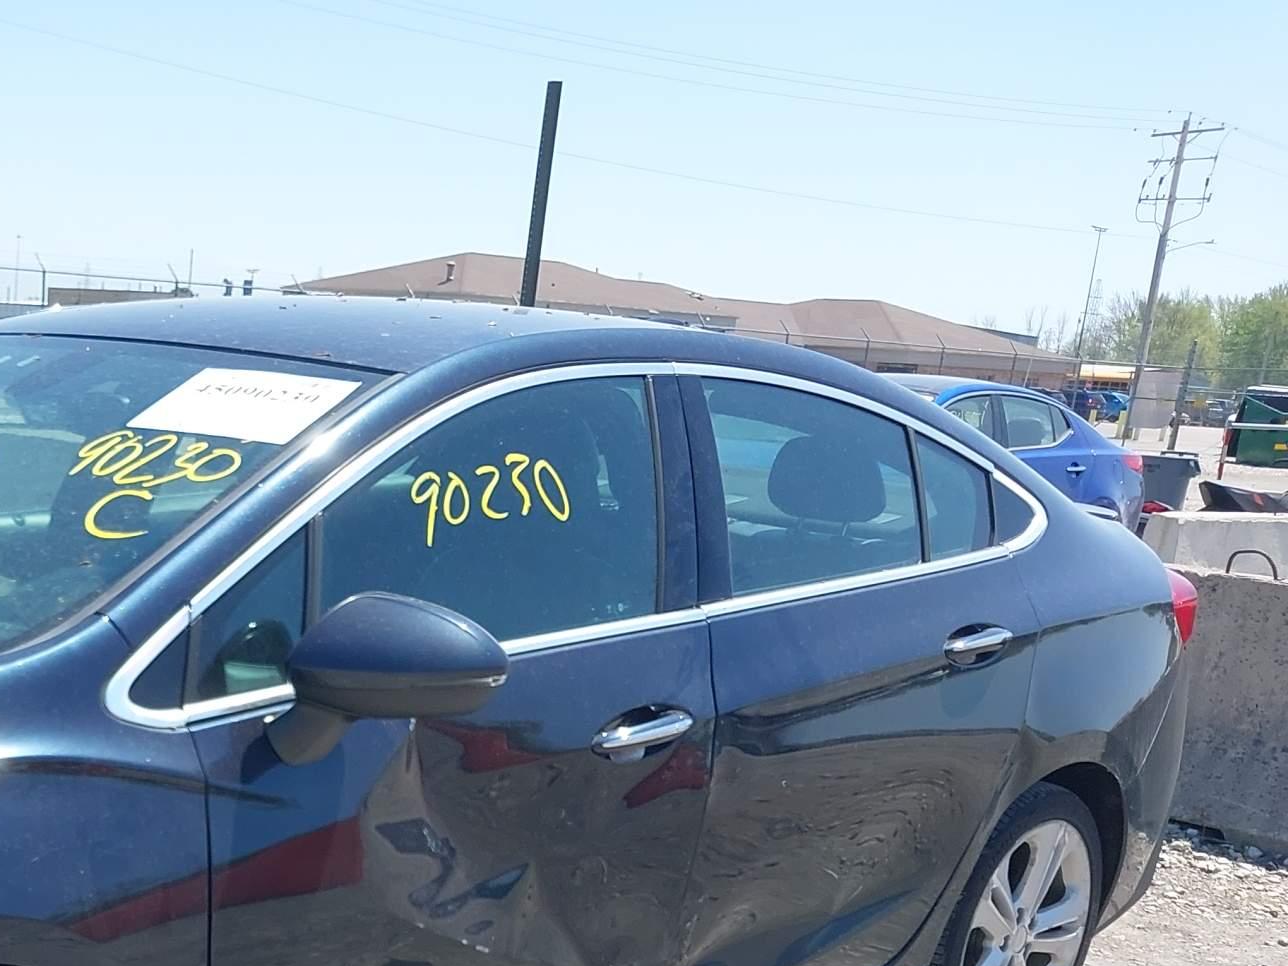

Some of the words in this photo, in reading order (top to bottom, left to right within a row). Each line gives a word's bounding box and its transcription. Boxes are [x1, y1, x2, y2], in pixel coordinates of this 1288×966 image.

[69, 430, 242, 487] 90230
[84, 489, 153, 539] C
[411, 453, 570, 547] 90230
